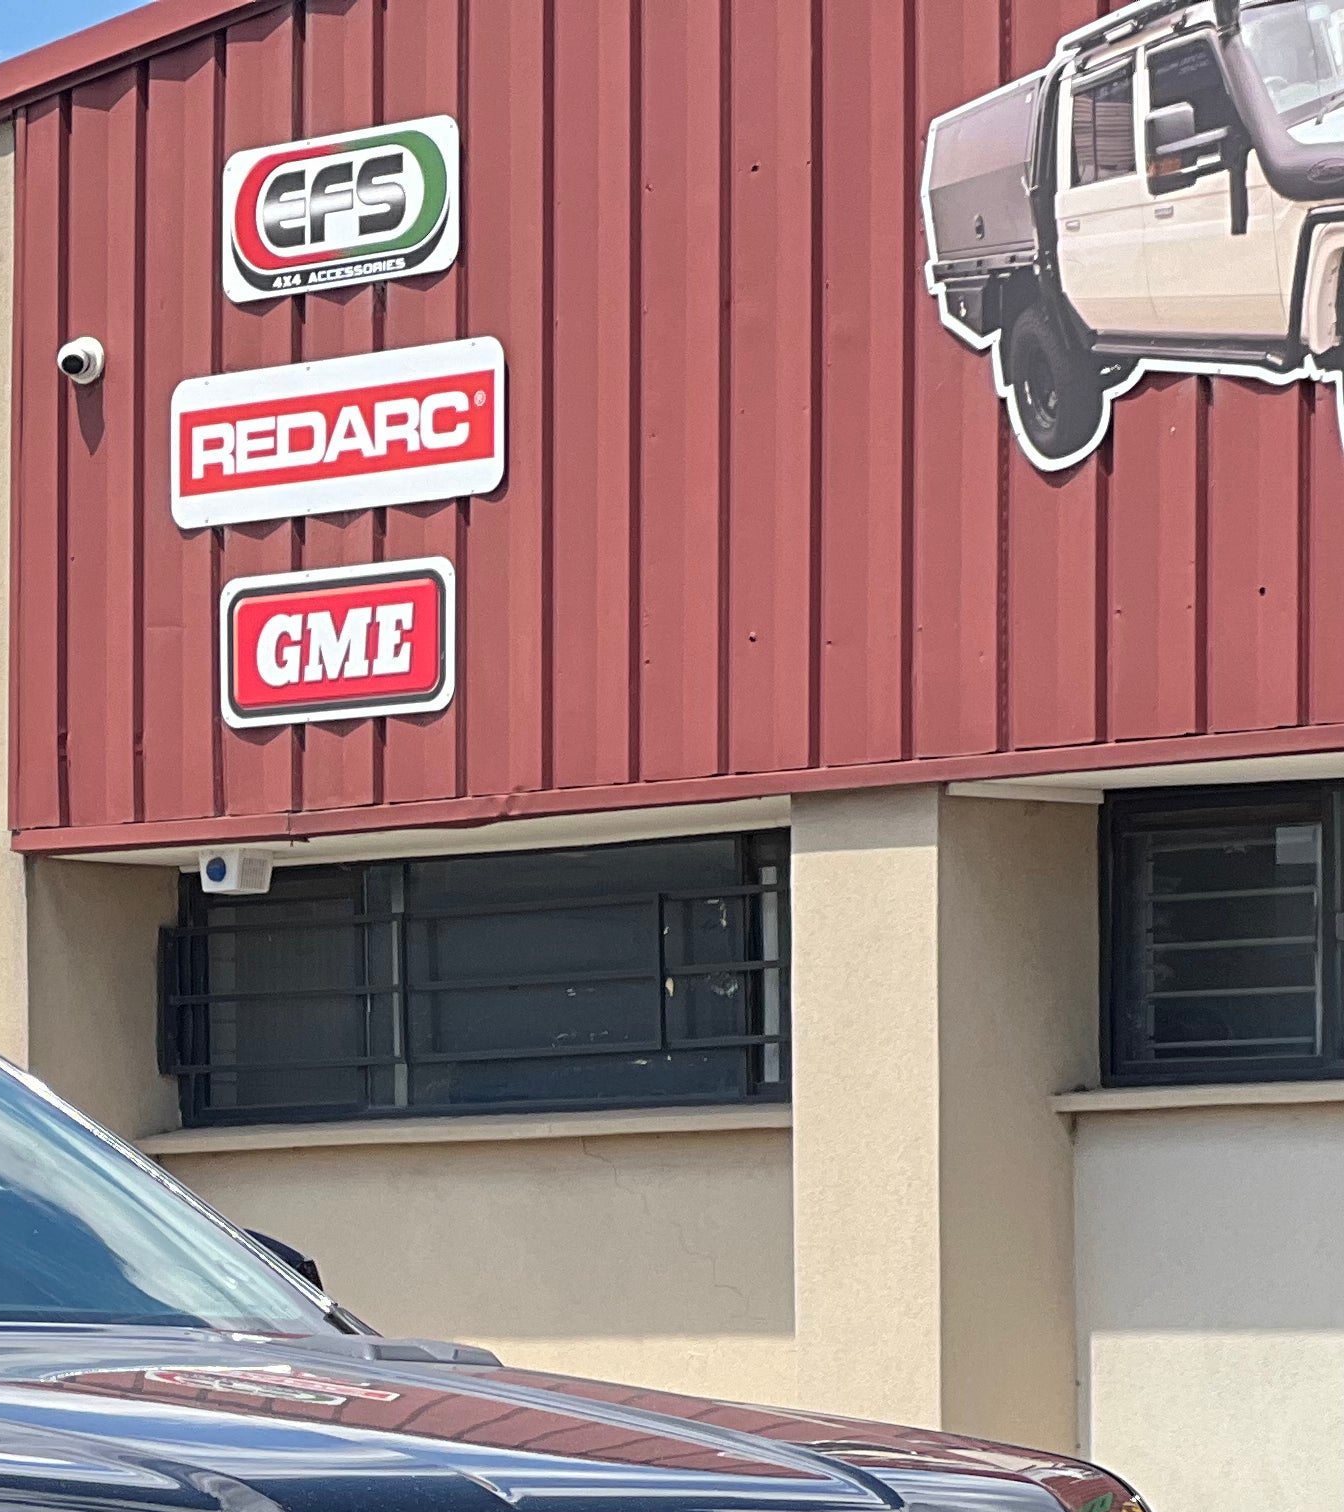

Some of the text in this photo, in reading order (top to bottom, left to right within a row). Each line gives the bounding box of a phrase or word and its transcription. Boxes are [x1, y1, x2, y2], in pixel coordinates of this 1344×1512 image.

[263, 152, 407, 249] EFS
[307, 256, 407, 286] ACCESSORIES
[191, 390, 471, 480] REDARC
[256, 601, 416, 687] GME
